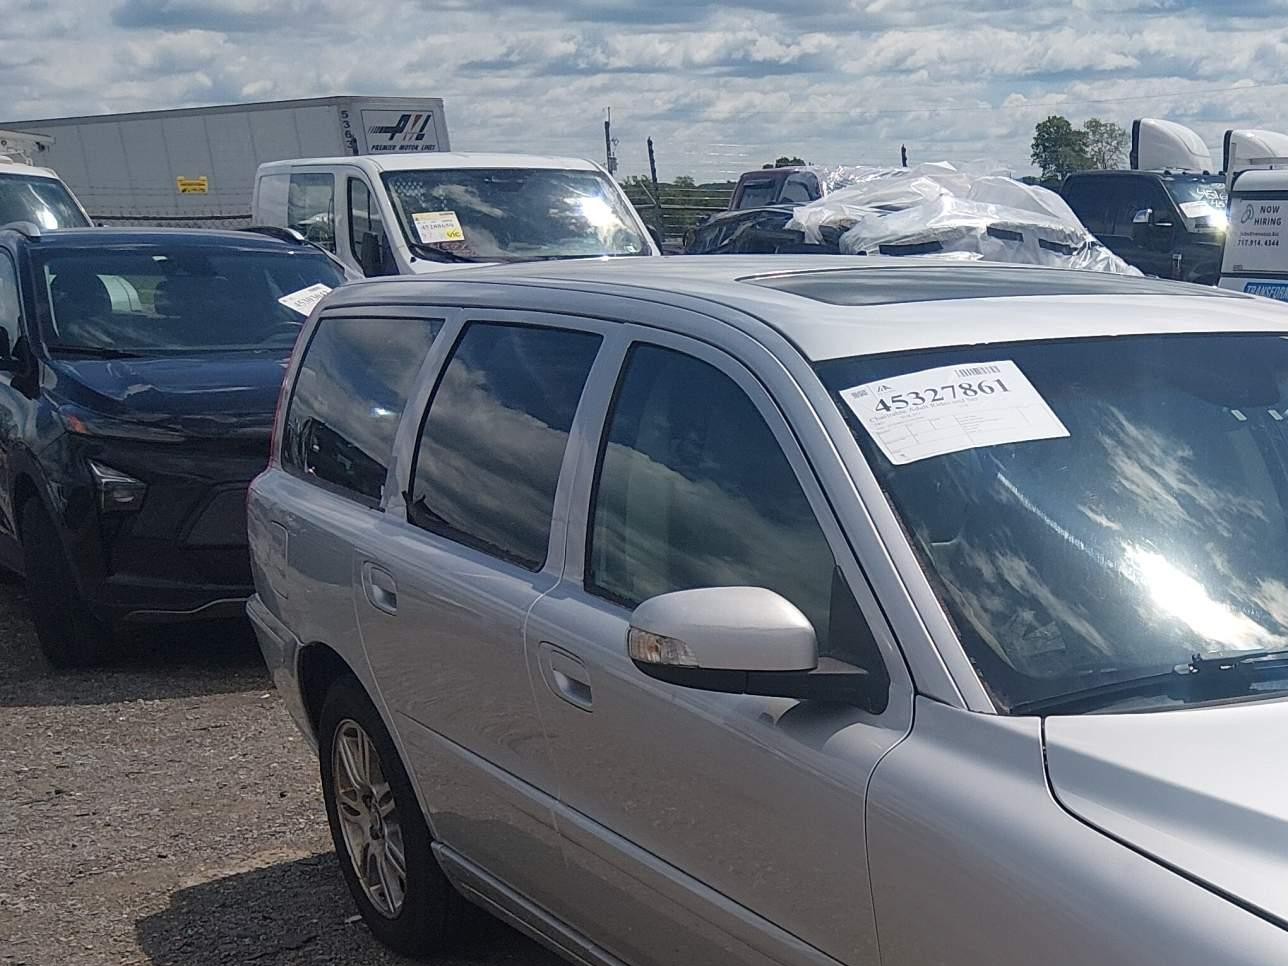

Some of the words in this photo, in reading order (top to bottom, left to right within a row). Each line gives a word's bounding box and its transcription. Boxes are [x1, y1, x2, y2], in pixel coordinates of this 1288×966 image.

[1260, 205, 1280, 214] NOW
[1254, 217, 1282, 226] HIRING
[876, 378, 1009, 413] 45327861
